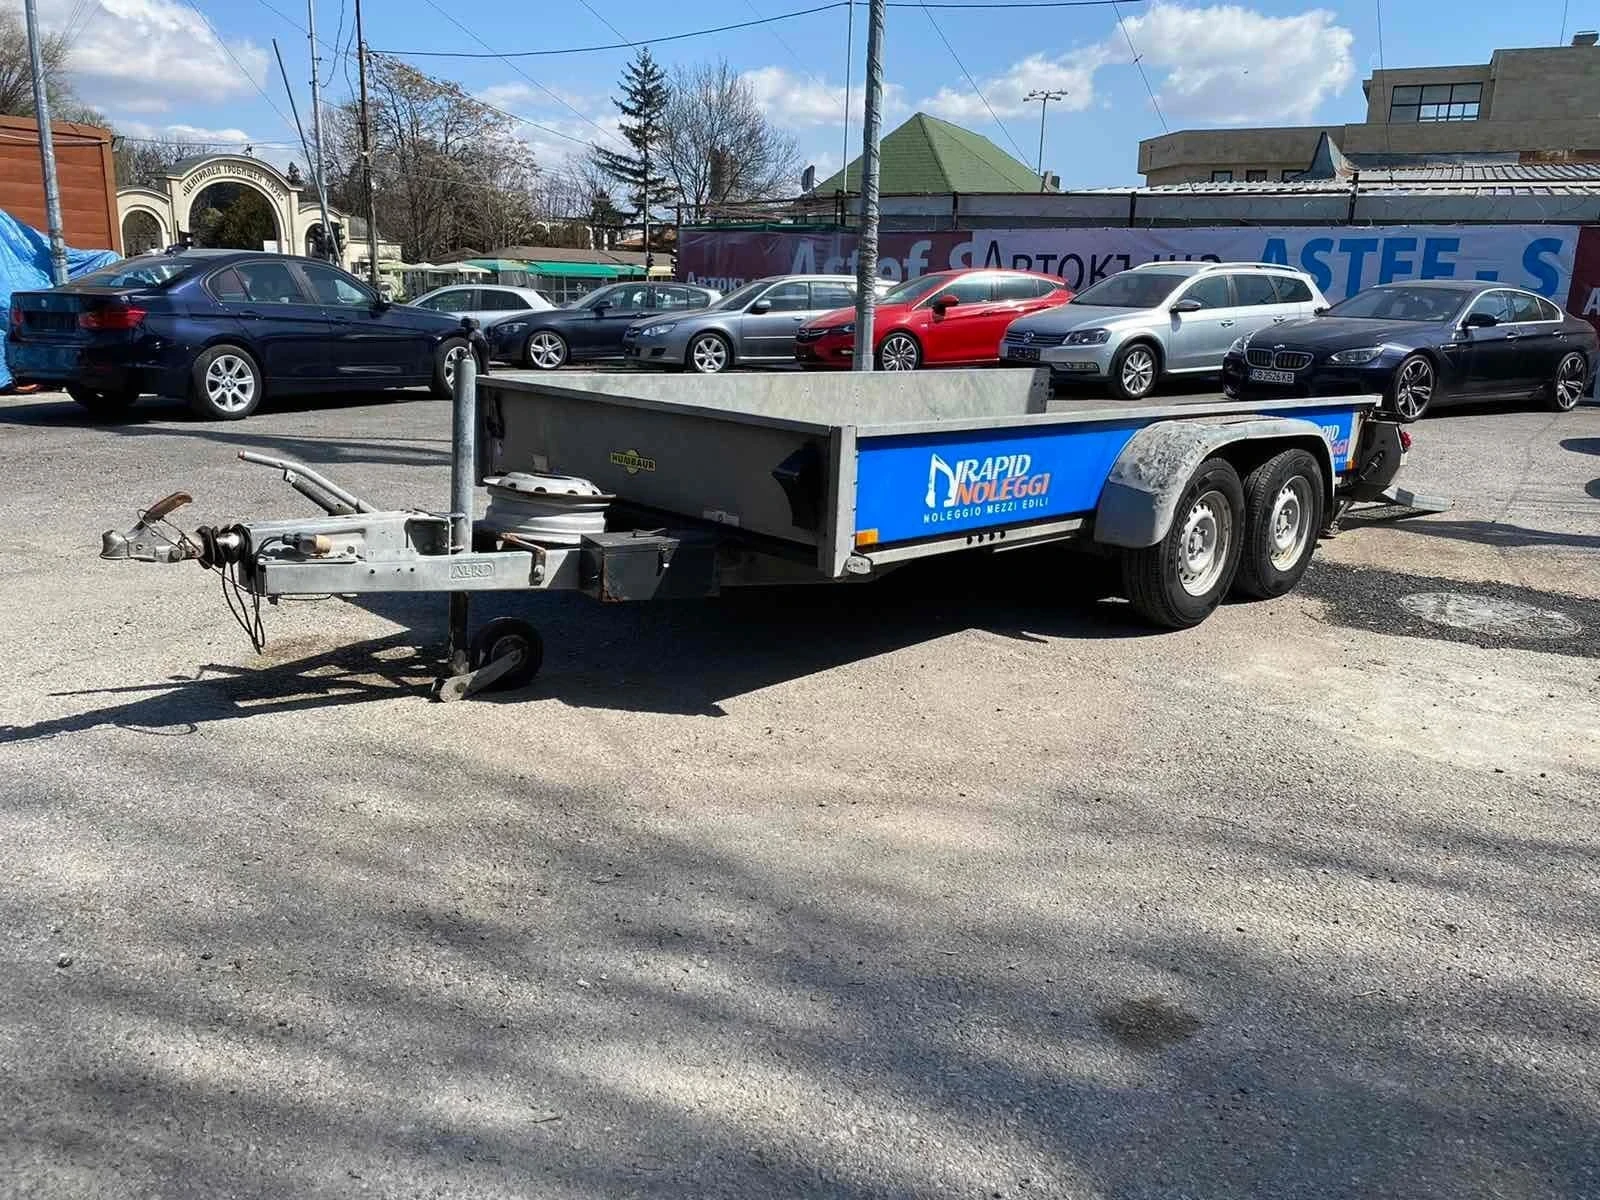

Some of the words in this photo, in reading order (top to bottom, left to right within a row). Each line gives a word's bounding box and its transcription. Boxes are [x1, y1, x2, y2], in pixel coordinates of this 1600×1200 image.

[611, 454, 654, 470] HUMBAUR
[960, 454, 1031, 483] RAPID
[955, 472, 1051, 505] NOLEGGI
[923, 507, 982, 524] NOLEGGIO
[987, 502, 1017, 515] MEZZI
[1022, 497, 1049, 509] EDILI
